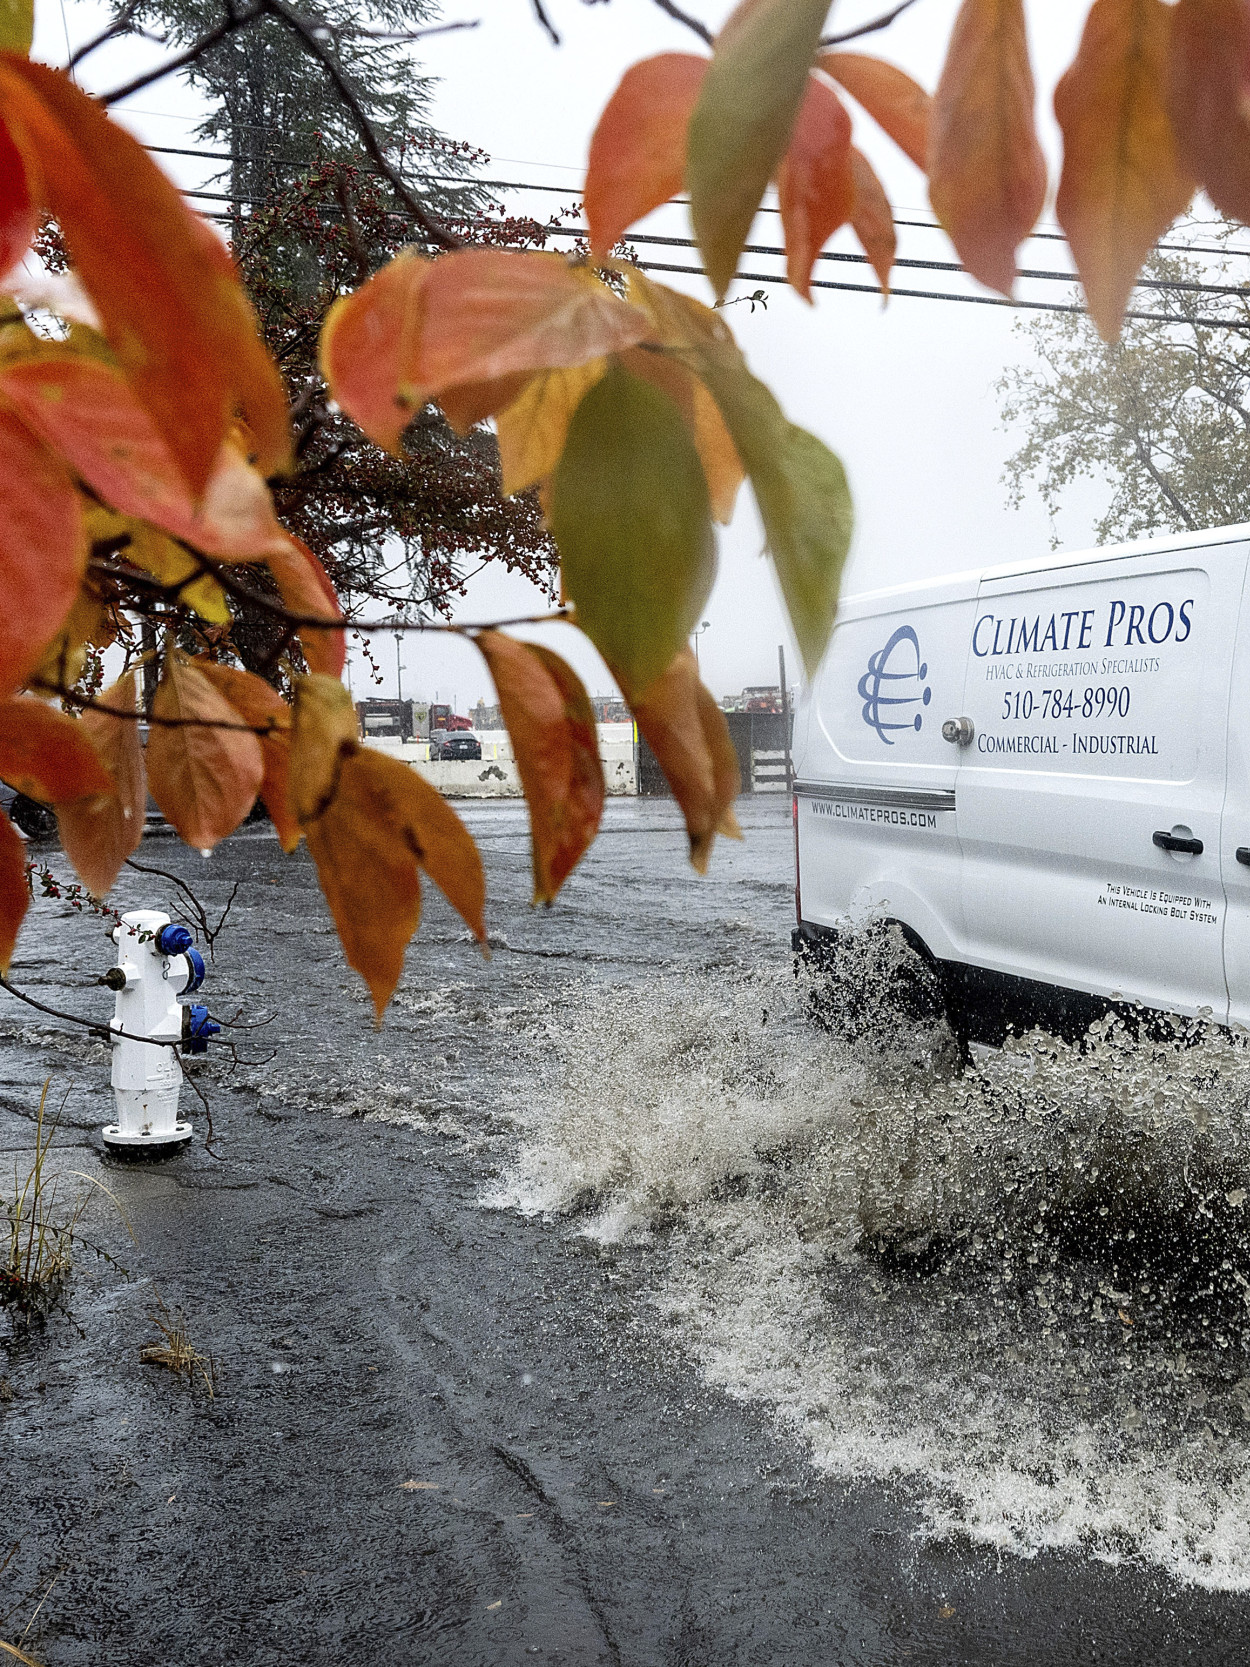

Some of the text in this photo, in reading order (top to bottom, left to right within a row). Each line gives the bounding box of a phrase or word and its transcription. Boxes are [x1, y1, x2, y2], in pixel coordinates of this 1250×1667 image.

[972, 599, 1195, 657] CLIMATE PROS
[985, 657, 1161, 681] HVAC & REFRIGERATION SPECIALISTS
[1001, 686, 1131, 720] 510-784-8990
[977, 733, 1059, 754] COMMERCIAL
[1072, 732, 1159, 755] INDUSTRIAL
[811, 801, 938, 829] WWW.CLIMATEPROS.COM
[1097, 895, 1218, 925] AN INTERNAL LOCKING BOLT SYSTEM
[1106, 883, 1212, 910] THIS VEHICLE IS EQUIPPED WITH
